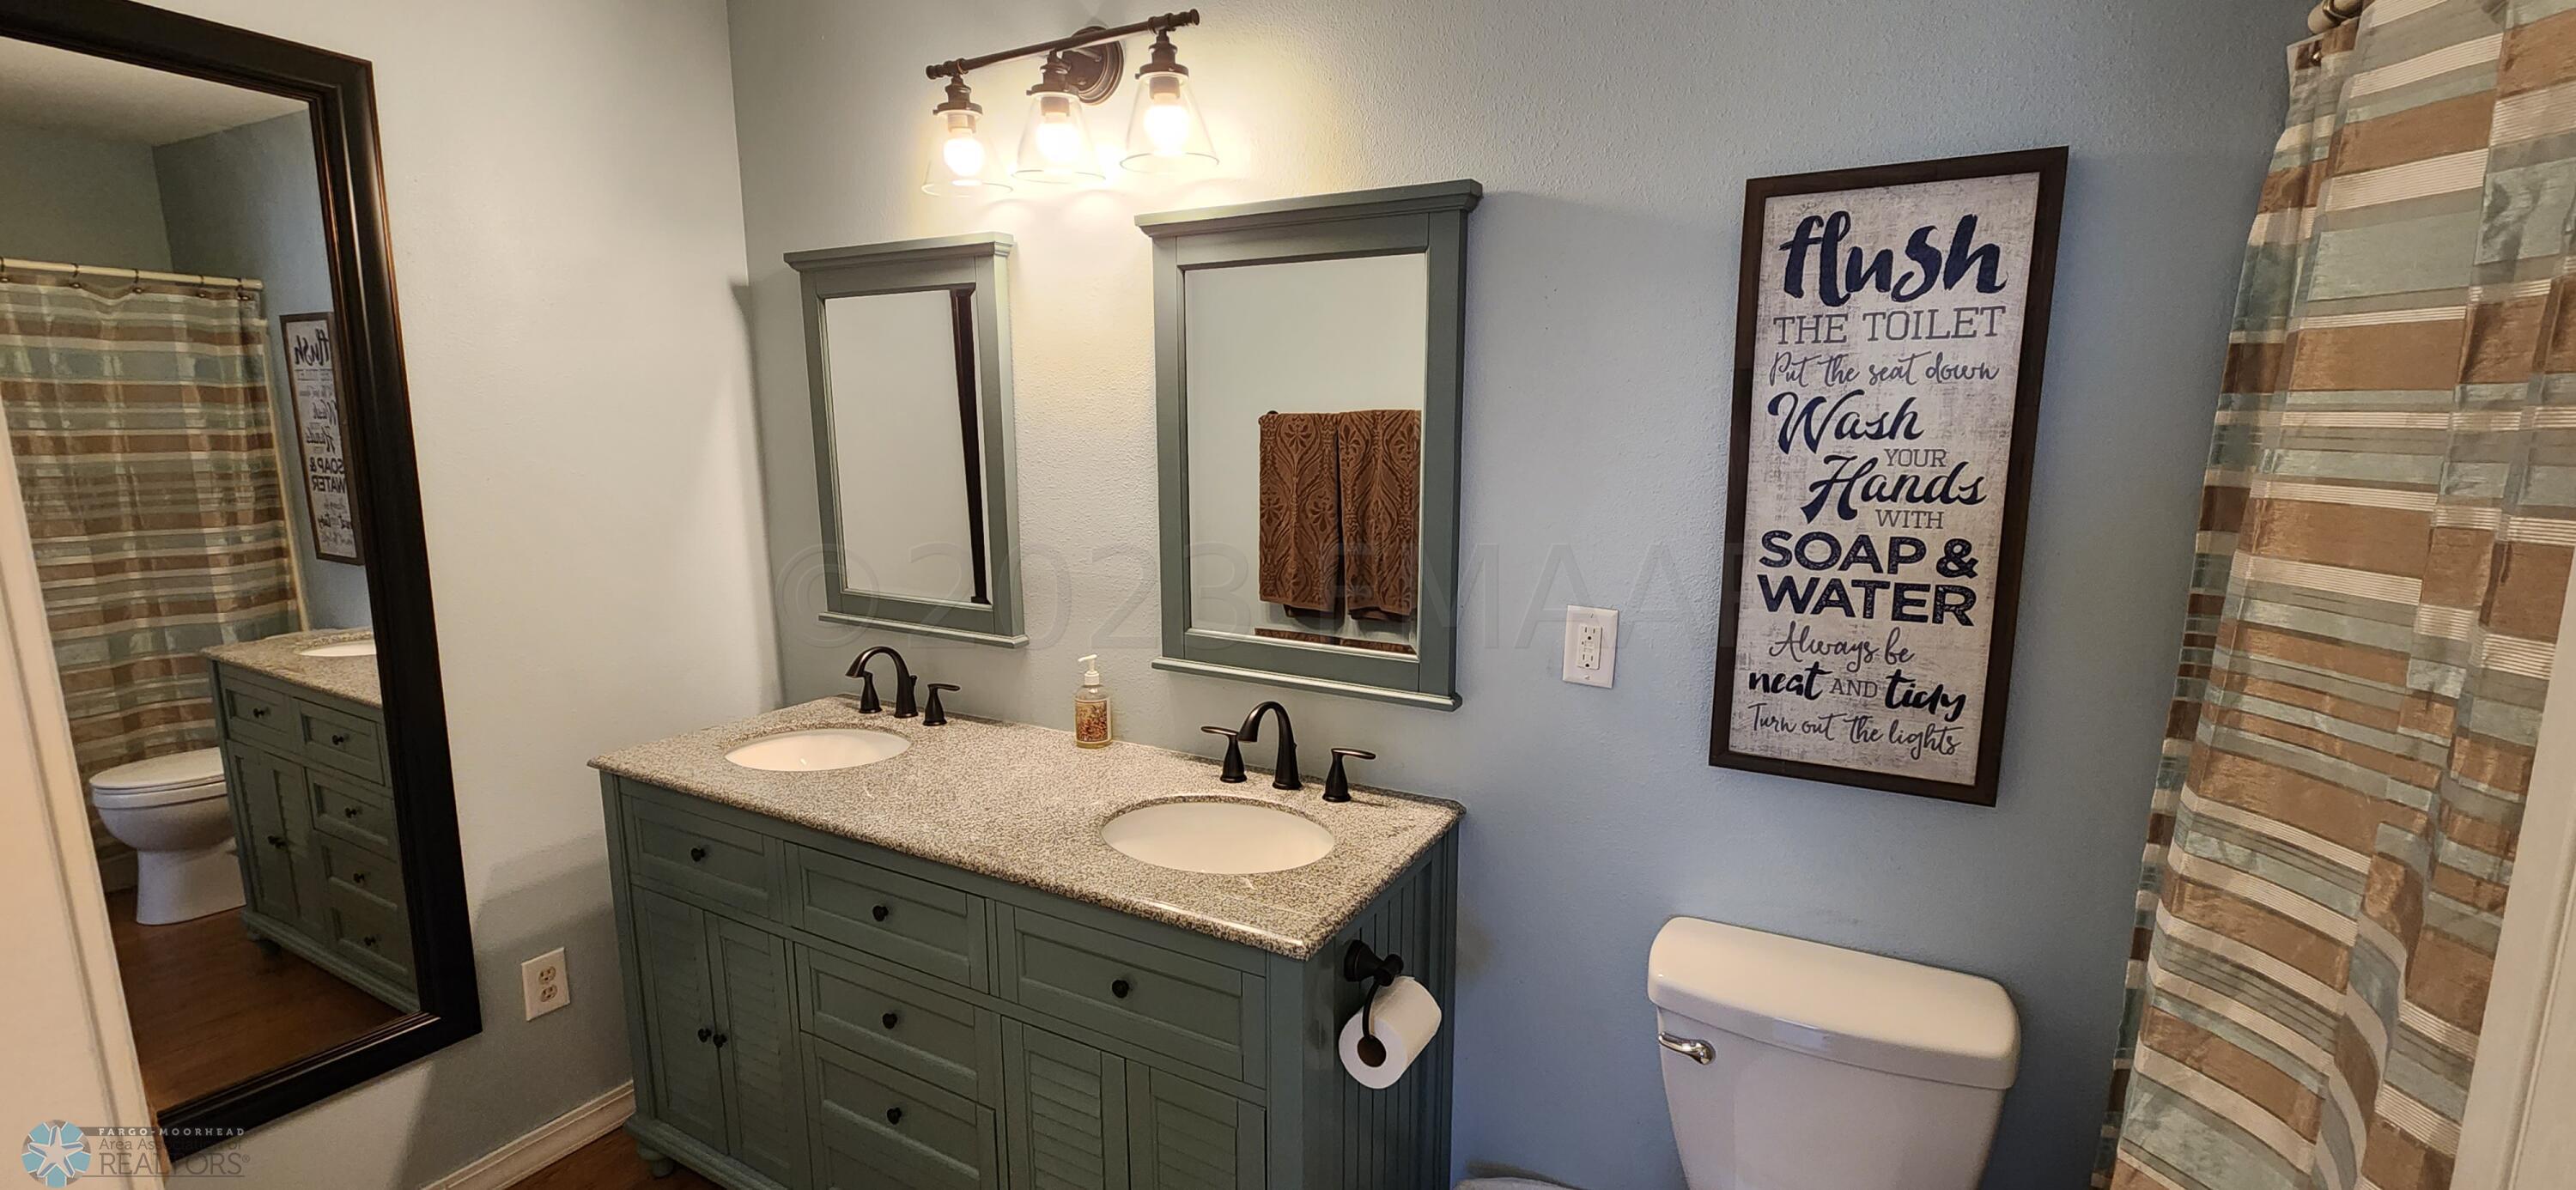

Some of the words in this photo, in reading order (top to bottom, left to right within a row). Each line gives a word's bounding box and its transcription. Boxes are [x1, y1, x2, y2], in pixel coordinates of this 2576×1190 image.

[1779, 211, 2008, 307] flush
[1773, 313, 1849, 344] THE
[1862, 306, 2006, 341] TOILET
[1769, 352, 1816, 387] Put
[1815, 352, 1860, 387] the
[1869, 351, 1932, 386] seat
[1925, 352, 1999, 380] down
[1767, 389, 1924, 454] Wash
[1884, 449, 1947, 468] YOUR
[1800, 454, 1987, 525] Hands
[1874, 508, 1944, 530] WITH
[1759, 530, 1927, 574] SOAP
[1935, 537, 1978, 580] &
[1757, 574, 1978, 627] WATER
[1769, 621, 1879, 672] Always
[1884, 627, 1915, 665] be
[1748, 662, 1832, 701] neat
[1829, 678, 1878, 699] AND
[1885, 670, 1966, 722] tidy
[1748, 703, 1796, 733] Turn
[1801, 713, 1844, 741] out
[1844, 714, 1884, 744] the
[1889, 723, 1965, 761] lights
